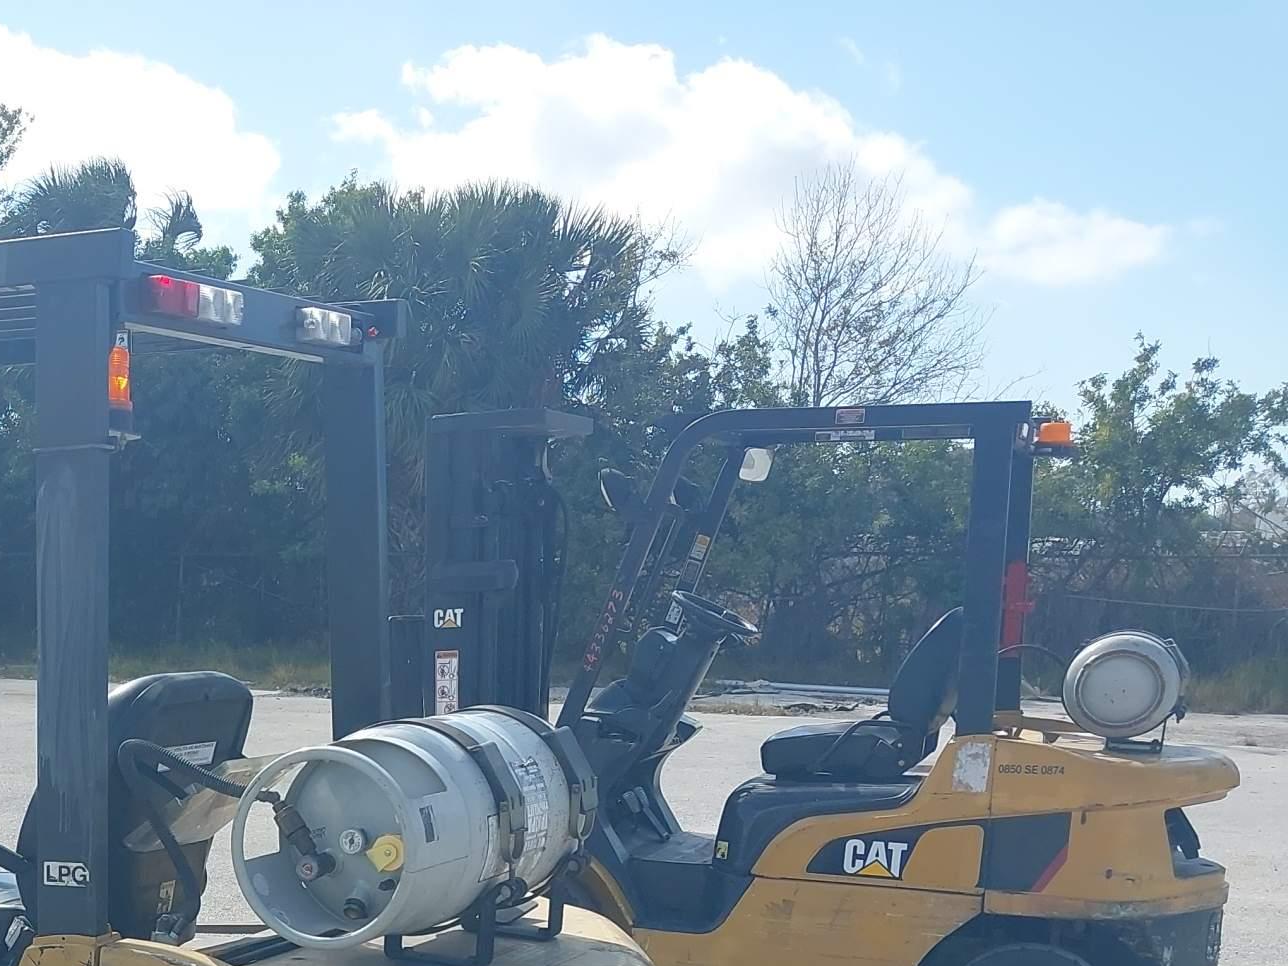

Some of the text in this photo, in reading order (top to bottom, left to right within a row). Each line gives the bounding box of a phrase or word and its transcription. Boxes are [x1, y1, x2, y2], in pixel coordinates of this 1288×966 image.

[434, 608, 464, 628] CAT
[999, 764, 1064, 775] 0850 SE 0874
[843, 839, 908, 878] CAT
[46, 864, 88, 886] LPG
